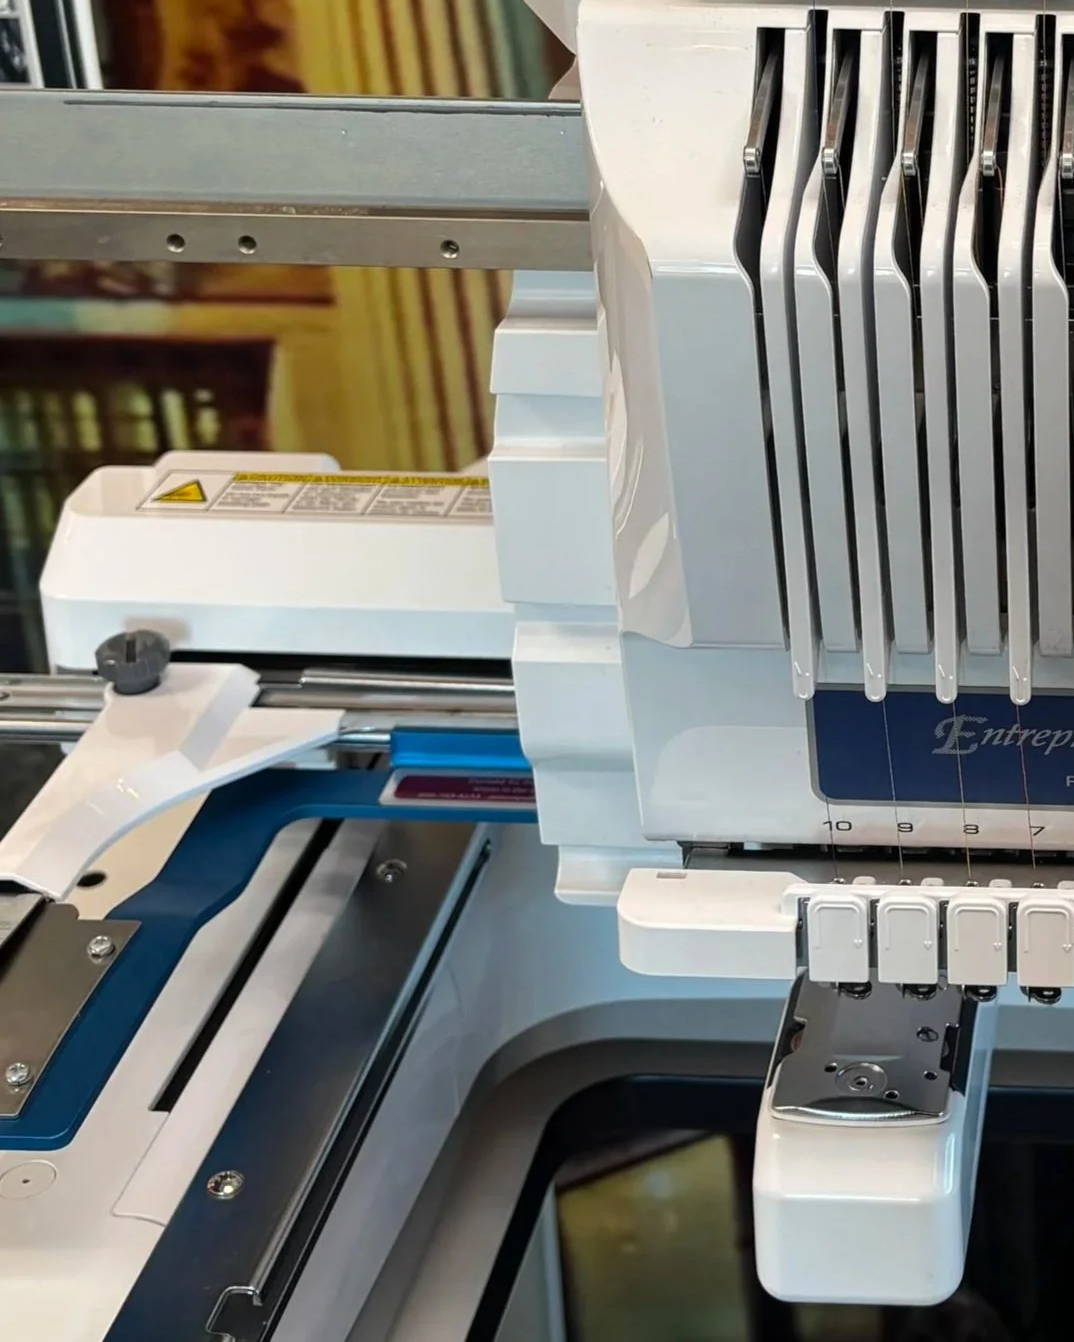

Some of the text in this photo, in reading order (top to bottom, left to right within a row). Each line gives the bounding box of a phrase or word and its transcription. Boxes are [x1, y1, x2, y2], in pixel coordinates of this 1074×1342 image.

[822, 820, 852, 831] 10
[897, 822, 913, 833] 9
[962, 824, 980, 835] 8
[1030, 826, 1046, 837] 7
